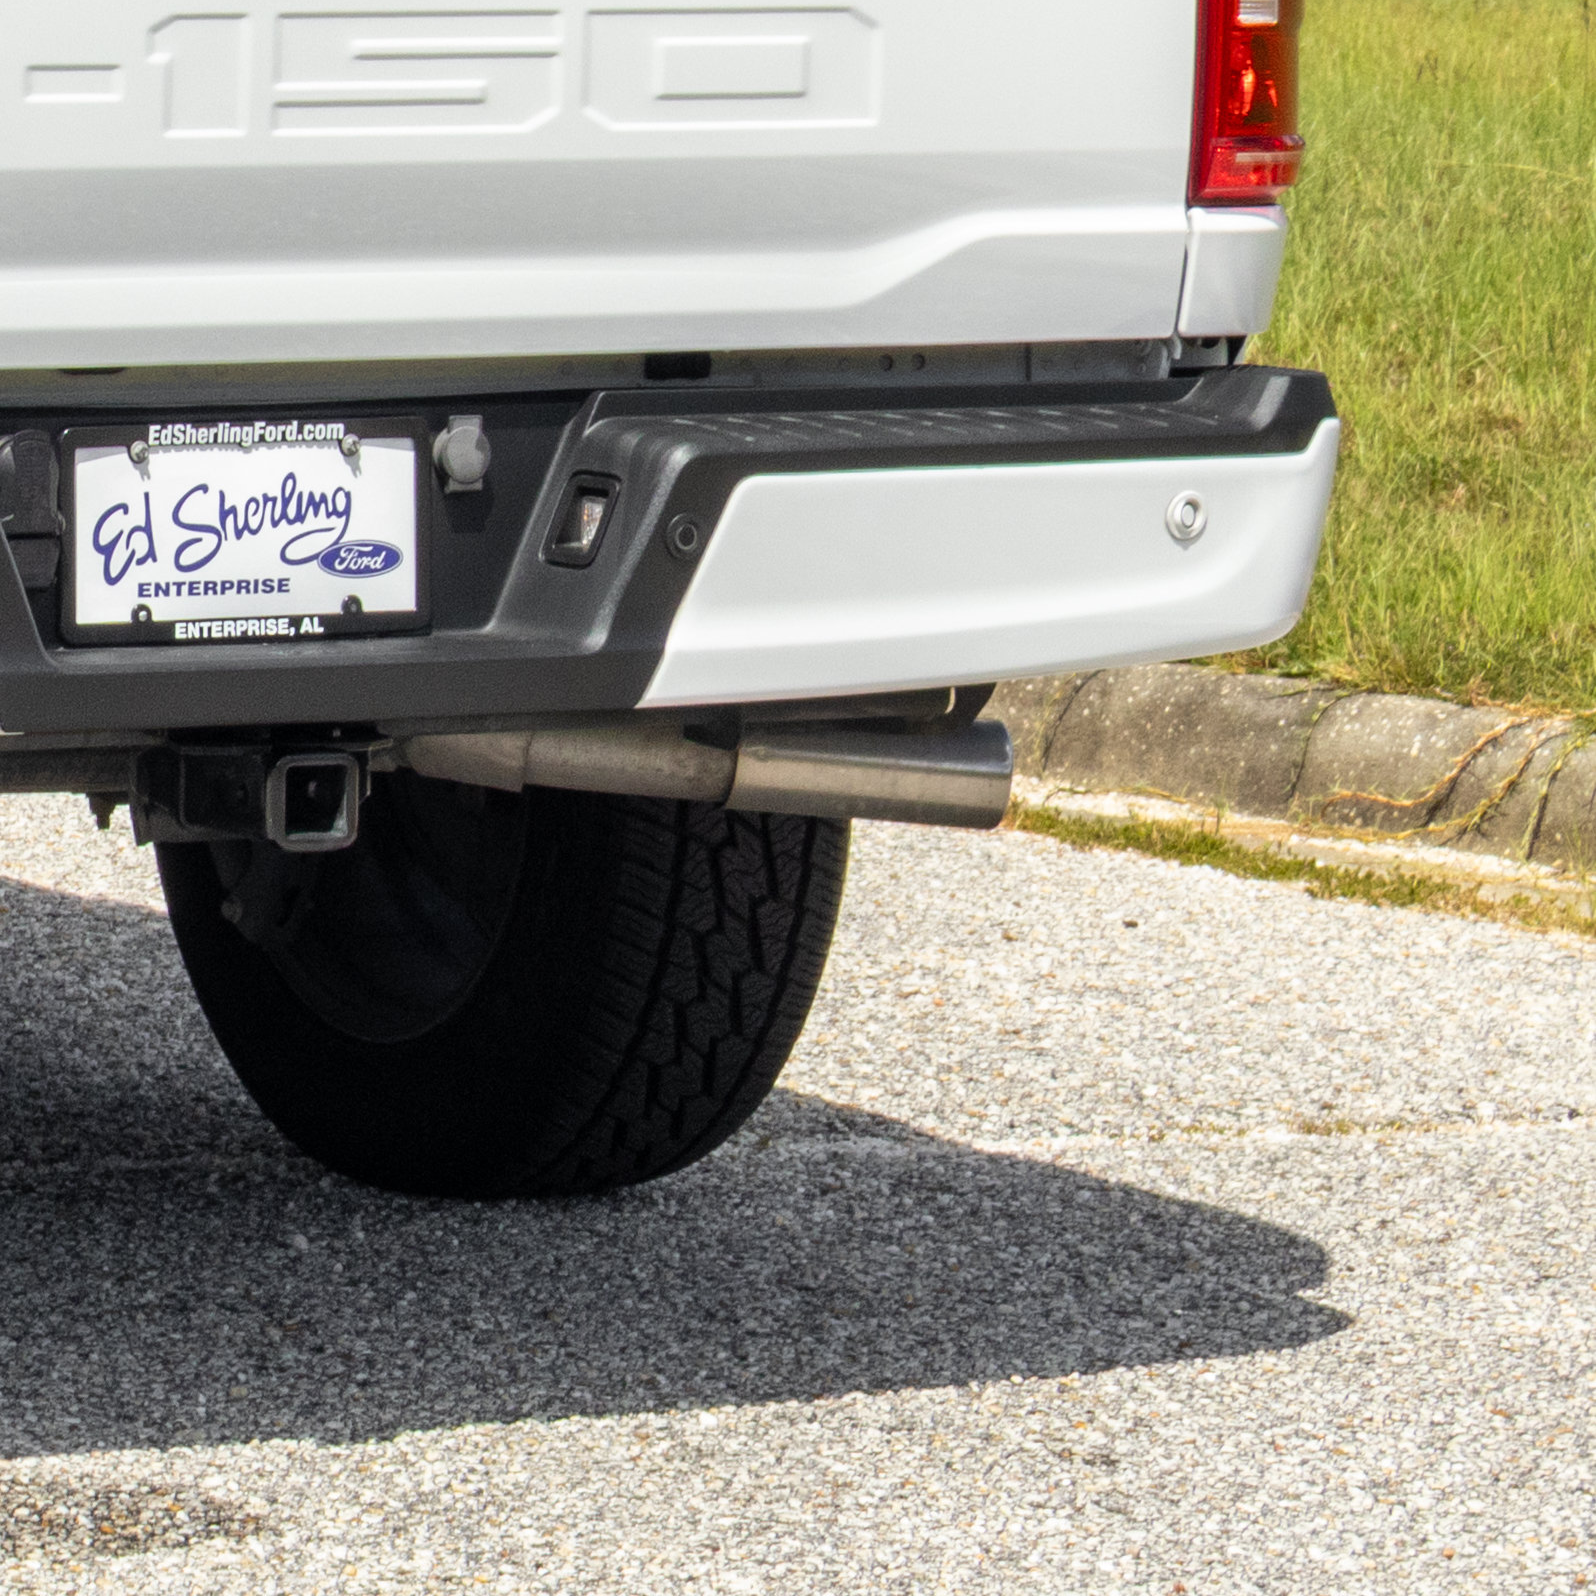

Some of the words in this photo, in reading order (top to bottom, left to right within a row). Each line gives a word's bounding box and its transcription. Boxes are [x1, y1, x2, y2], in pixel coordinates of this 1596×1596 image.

[148, 422, 344, 447] EdSherlingFord.com
[93, 491, 157, 586] Ed
[172, 472, 351, 572] Sherling
[334, 545, 384, 571] Ford
[137, 577, 290, 598] ENTERPRISE
[174, 619, 296, 640] ENTERPRISE,
[300, 617, 324, 635] AL
